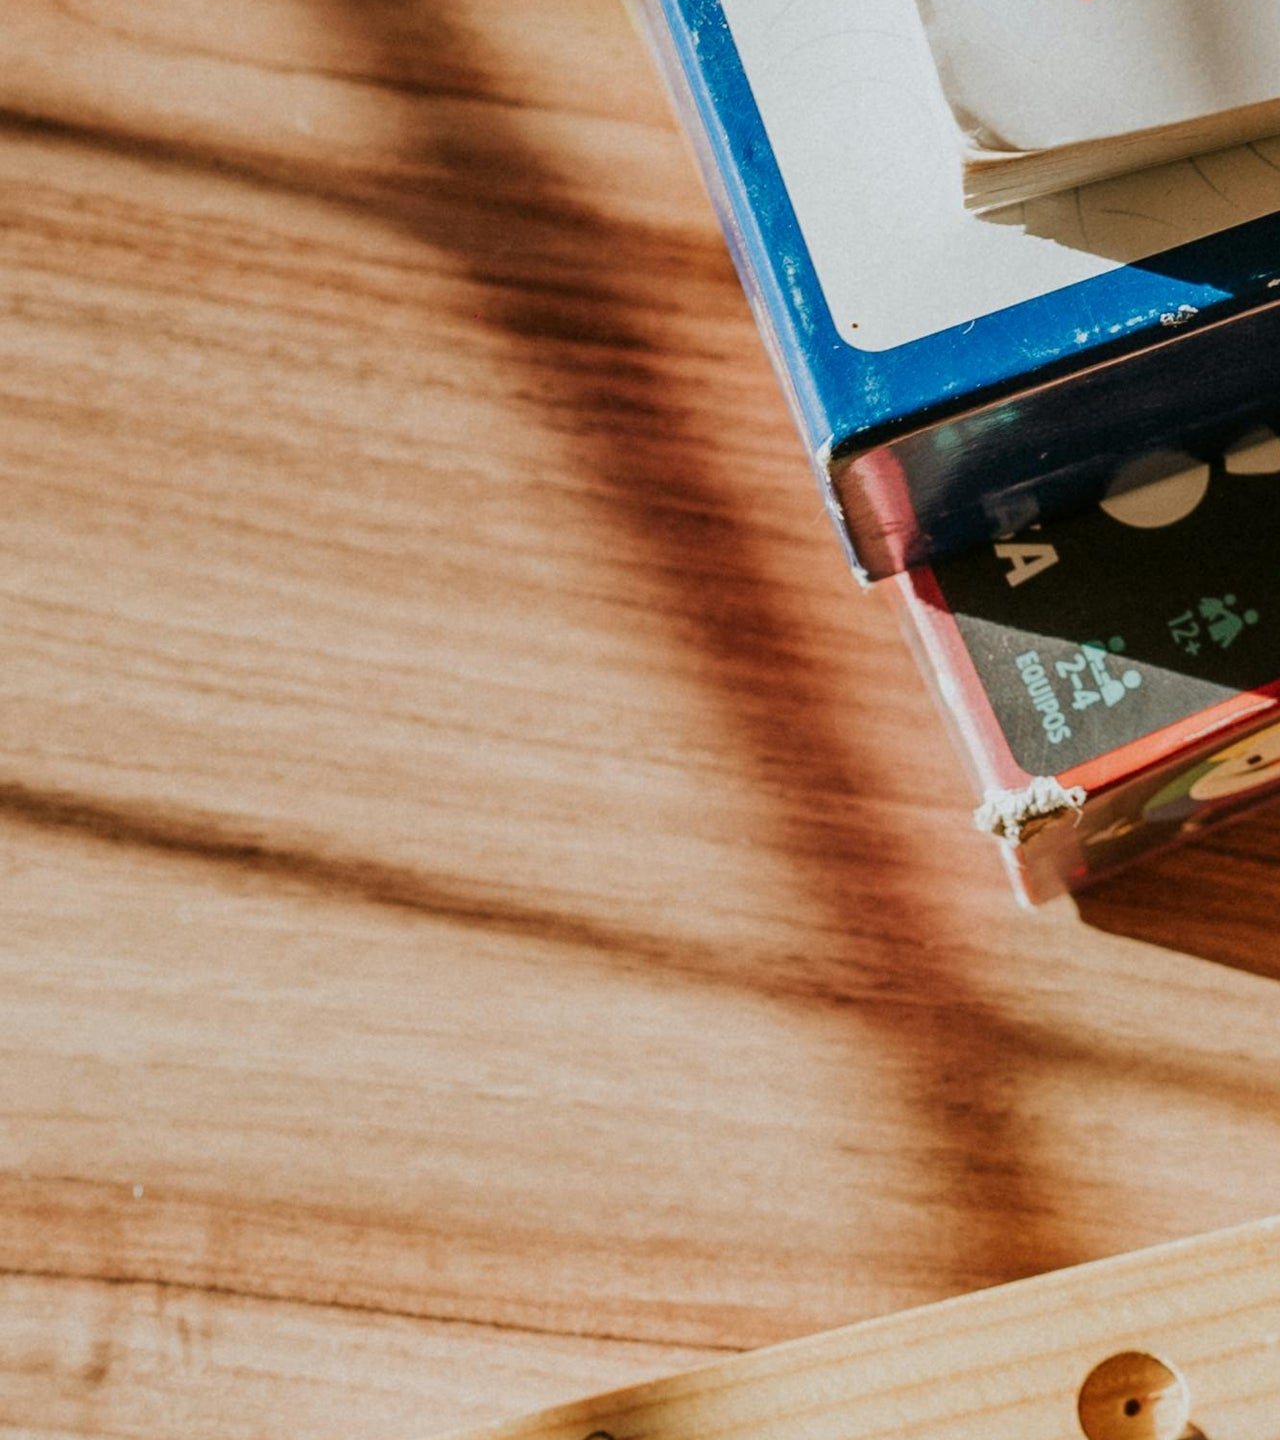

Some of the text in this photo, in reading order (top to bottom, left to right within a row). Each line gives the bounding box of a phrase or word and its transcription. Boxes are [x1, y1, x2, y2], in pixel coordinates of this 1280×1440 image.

[1167, 609, 1202, 656] 12+
[1015, 650, 1072, 745] EQUIPOS
[1055, 655, 1100, 711] 2-4
